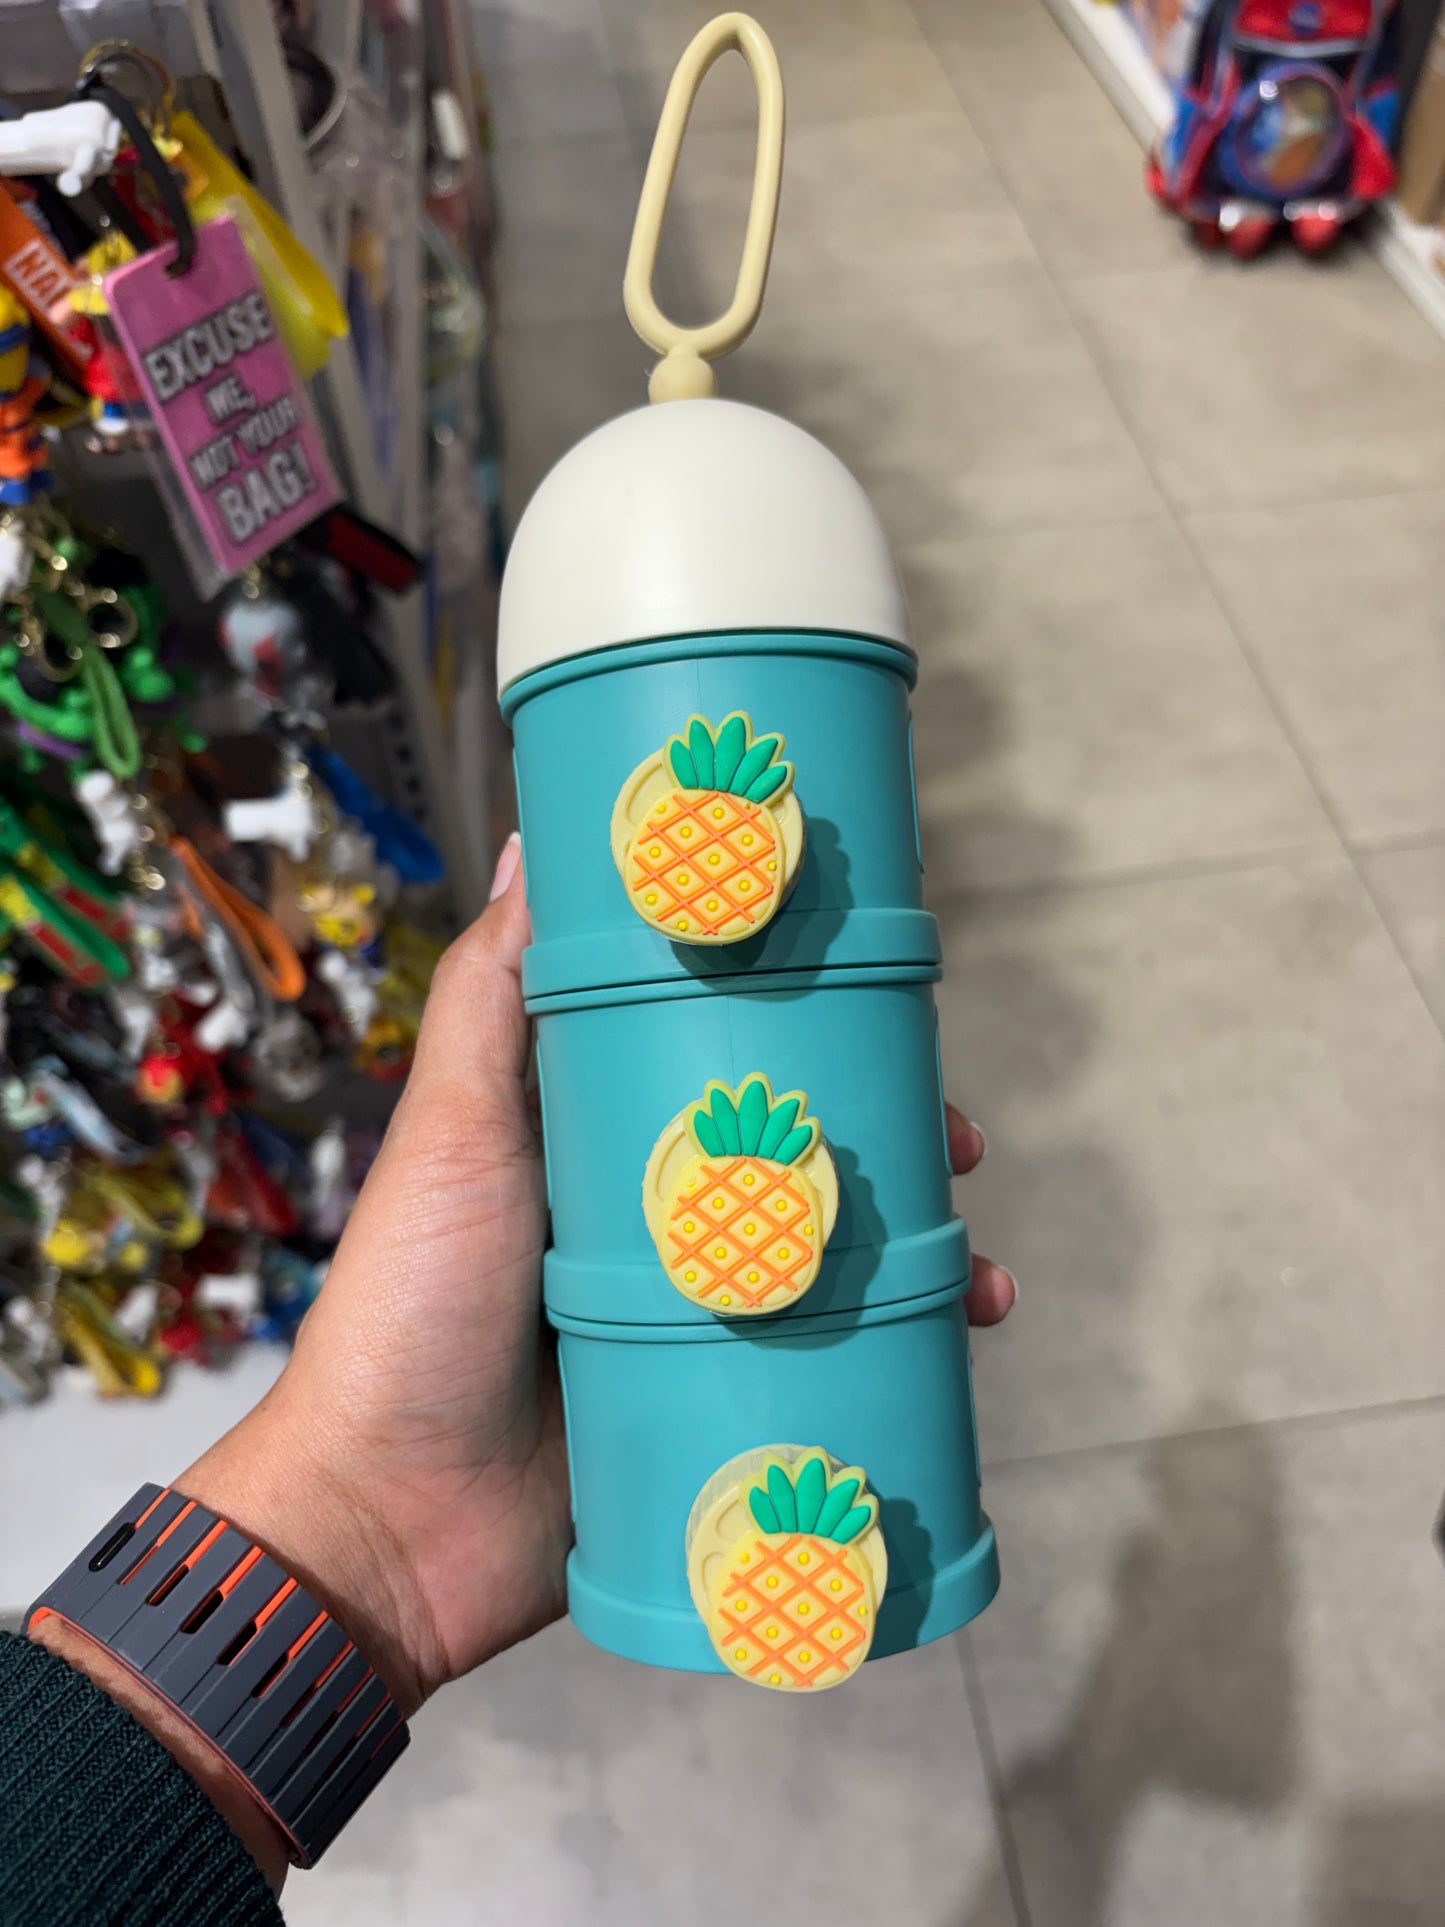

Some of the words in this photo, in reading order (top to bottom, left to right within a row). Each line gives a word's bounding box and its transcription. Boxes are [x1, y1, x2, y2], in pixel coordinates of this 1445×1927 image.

[144, 292, 274, 400] EXCUSE
[189, 434, 240, 487] NOT
[235, 396, 299, 451] YOUR
[216, 442, 315, 542] BAG!
